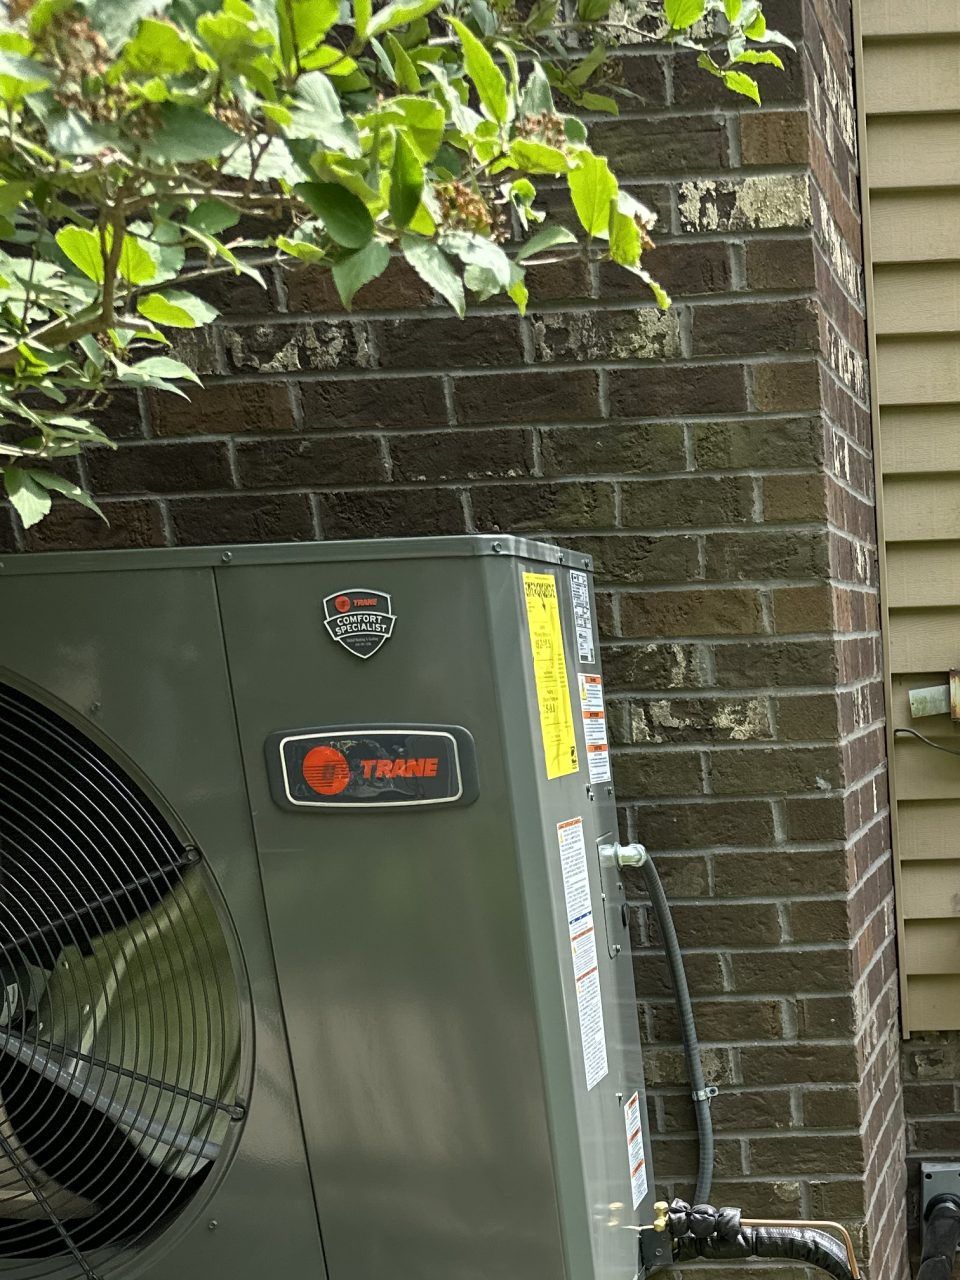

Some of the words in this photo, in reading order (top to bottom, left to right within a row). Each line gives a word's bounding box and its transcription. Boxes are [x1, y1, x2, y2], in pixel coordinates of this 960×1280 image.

[353, 598, 377, 606] TRANE
[337, 615, 382, 625] COMFORT
[335, 623, 386, 634] SPECIALIST
[360, 758, 439, 778] TRANE
